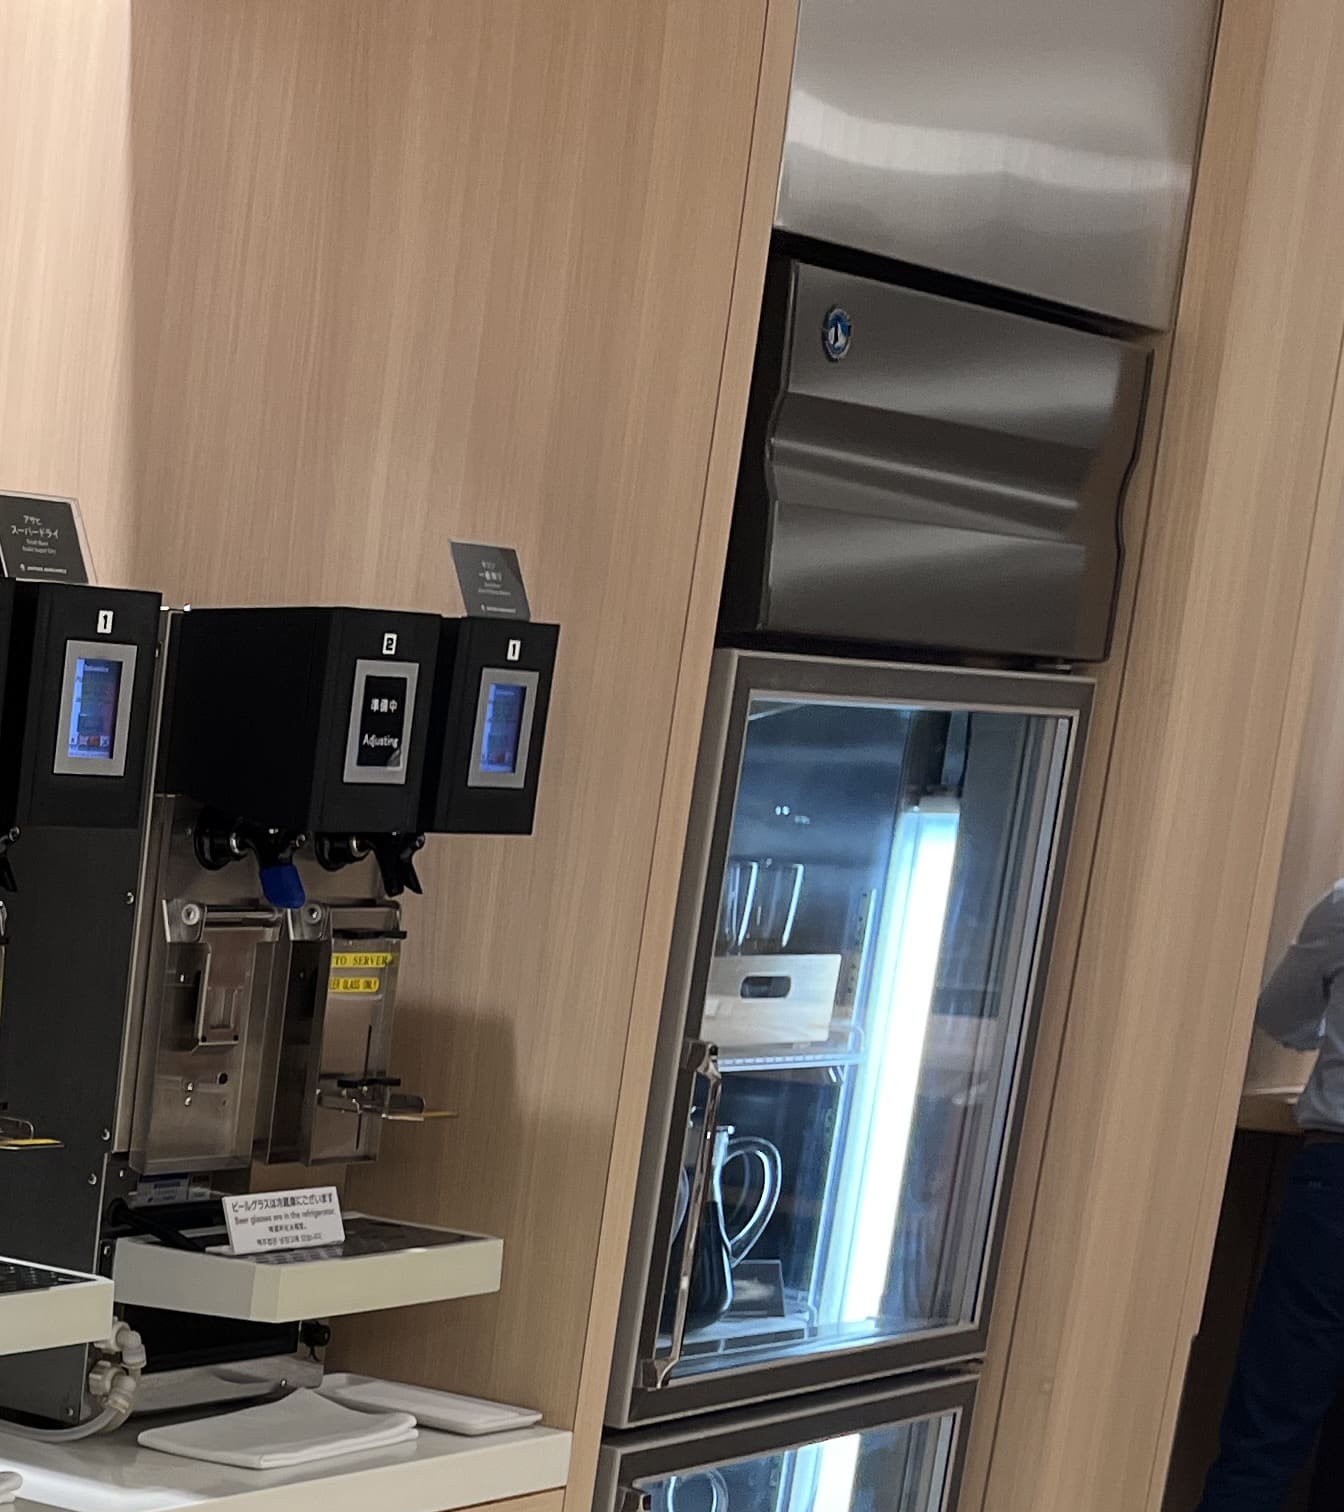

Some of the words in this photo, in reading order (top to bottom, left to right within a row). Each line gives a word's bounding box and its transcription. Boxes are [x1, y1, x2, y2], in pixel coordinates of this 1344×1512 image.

[10, 525, 59, 539] スーパードライ
[103, 613, 109, 630] 1
[386, 637, 394, 651] 2
[511, 643, 517, 656] 1
[362, 733, 399, 748] Adjusting
[353, 955, 389, 966] SERVER
